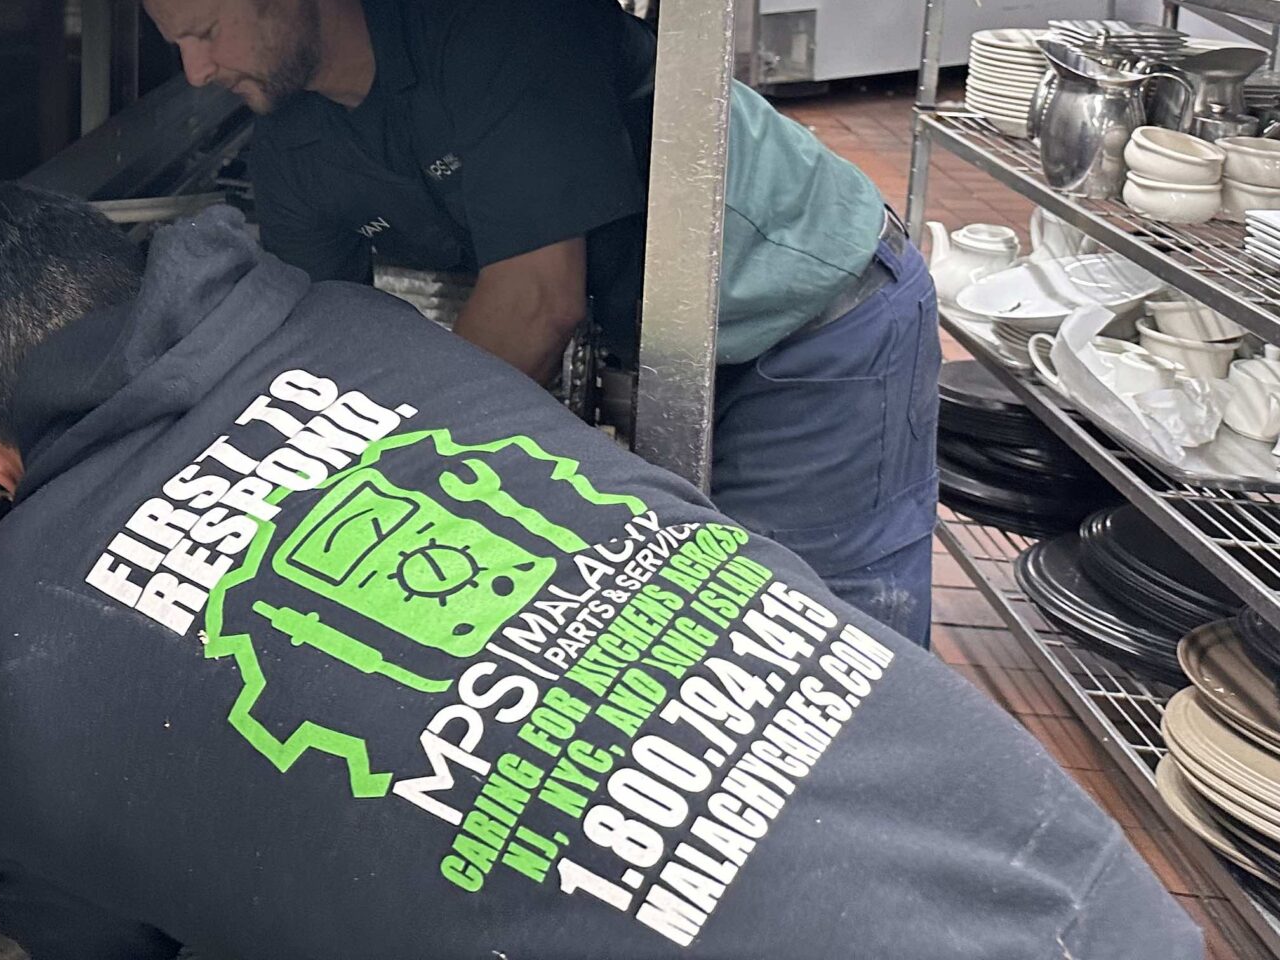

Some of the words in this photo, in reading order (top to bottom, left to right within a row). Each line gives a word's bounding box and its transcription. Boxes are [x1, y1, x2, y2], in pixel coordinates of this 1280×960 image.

[85, 435, 260, 608] FIRST
[234, 369, 339, 440] TO
[134, 391, 419, 637] RESPOND.
[601, 590, 631, 604] &
[614, 523, 701, 591] SERVIC
[392, 661, 539, 827] MPS
[440, 753, 545, 893] CARING
[517, 686, 592, 758] FOR
[564, 584, 685, 698] KITCHENS
[658, 523, 750, 595] ACROSS
[501, 825, 570, 884] NJ,
[538, 739, 626, 819] NYC,
[595, 667, 667, 738] AND
[641, 617, 719, 680] LONG
[689, 555, 774, 630] ISLAND
[543, 600, 615, 670] PARTS
[557, 581, 839, 912] 1.800.794.1415
[635, 623, 896, 948] MALACHYCARES.COM
